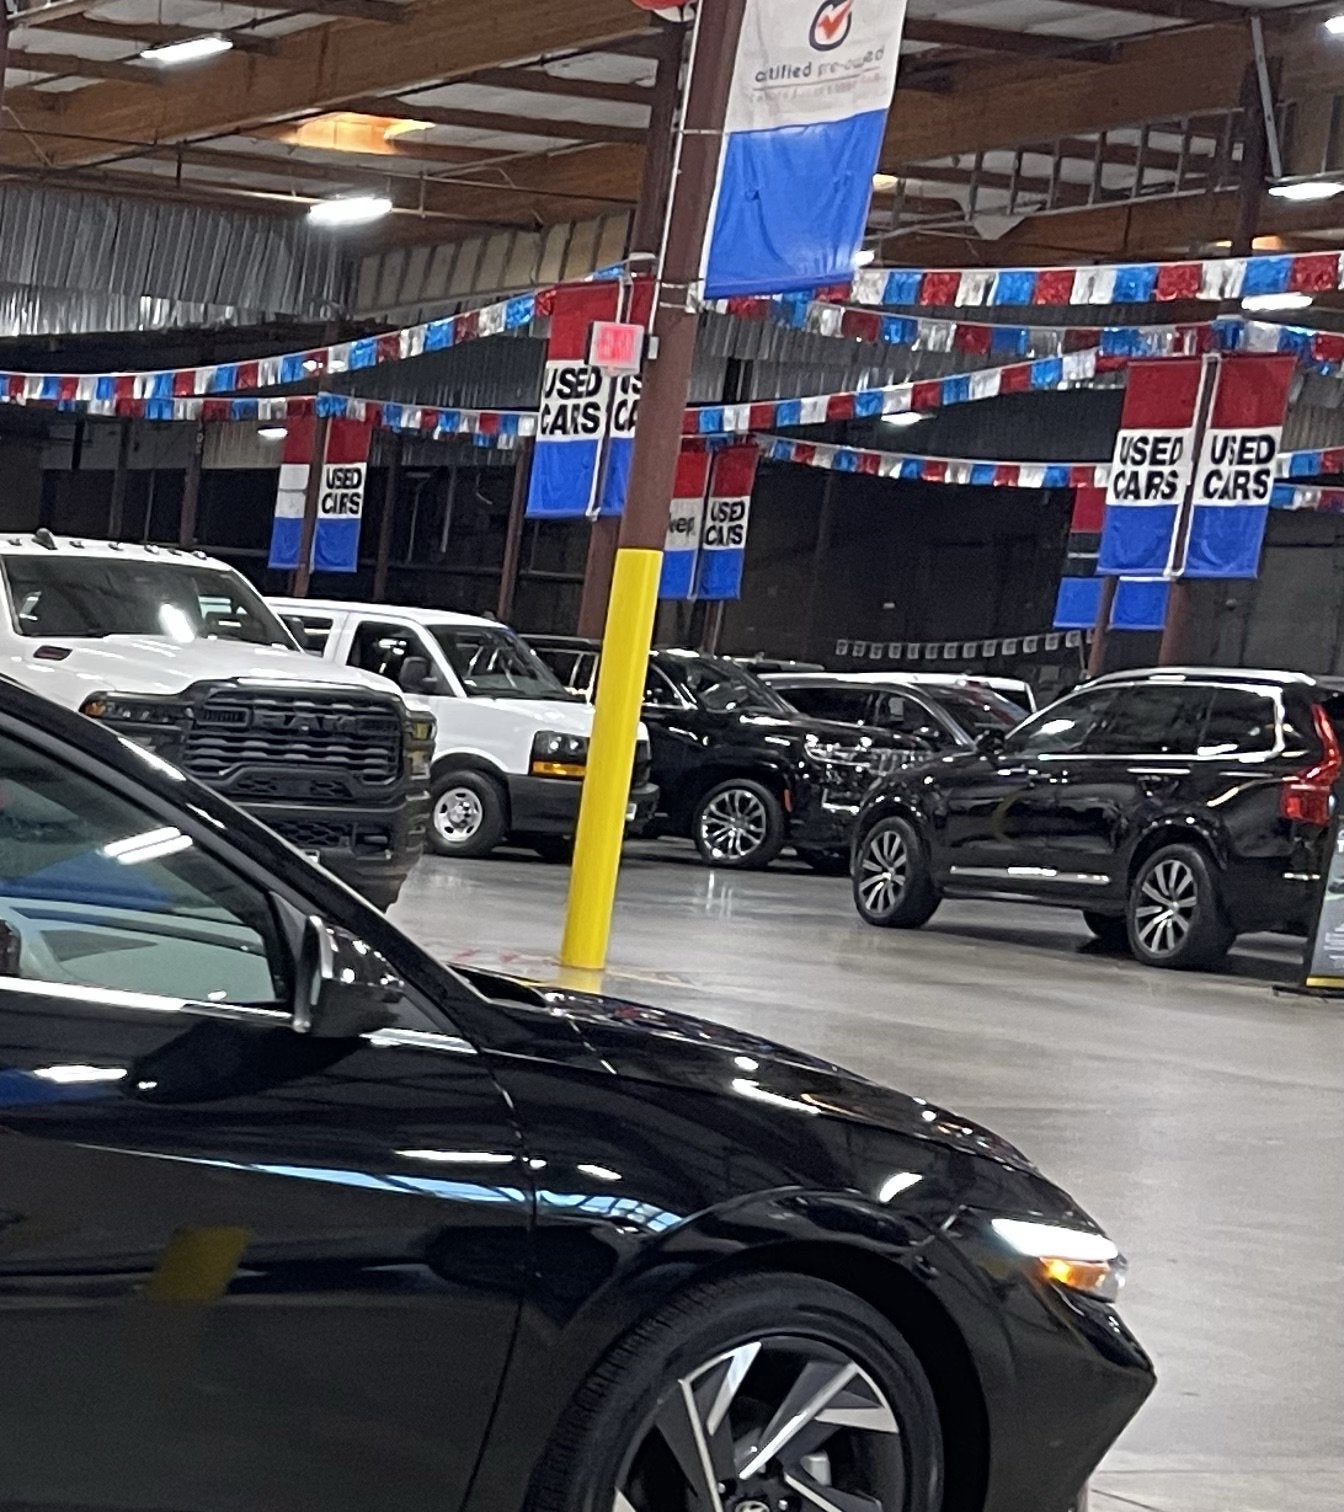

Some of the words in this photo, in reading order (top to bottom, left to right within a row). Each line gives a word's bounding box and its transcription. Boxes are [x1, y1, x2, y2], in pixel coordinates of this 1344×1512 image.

[544, 366, 603, 400] USED
[541, 401, 602, 435] CARS
[1120, 436, 1184, 466] USED
[1211, 434, 1276, 466] USED
[1114, 469, 1179, 500] CARS
[1203, 469, 1271, 500] CARS
